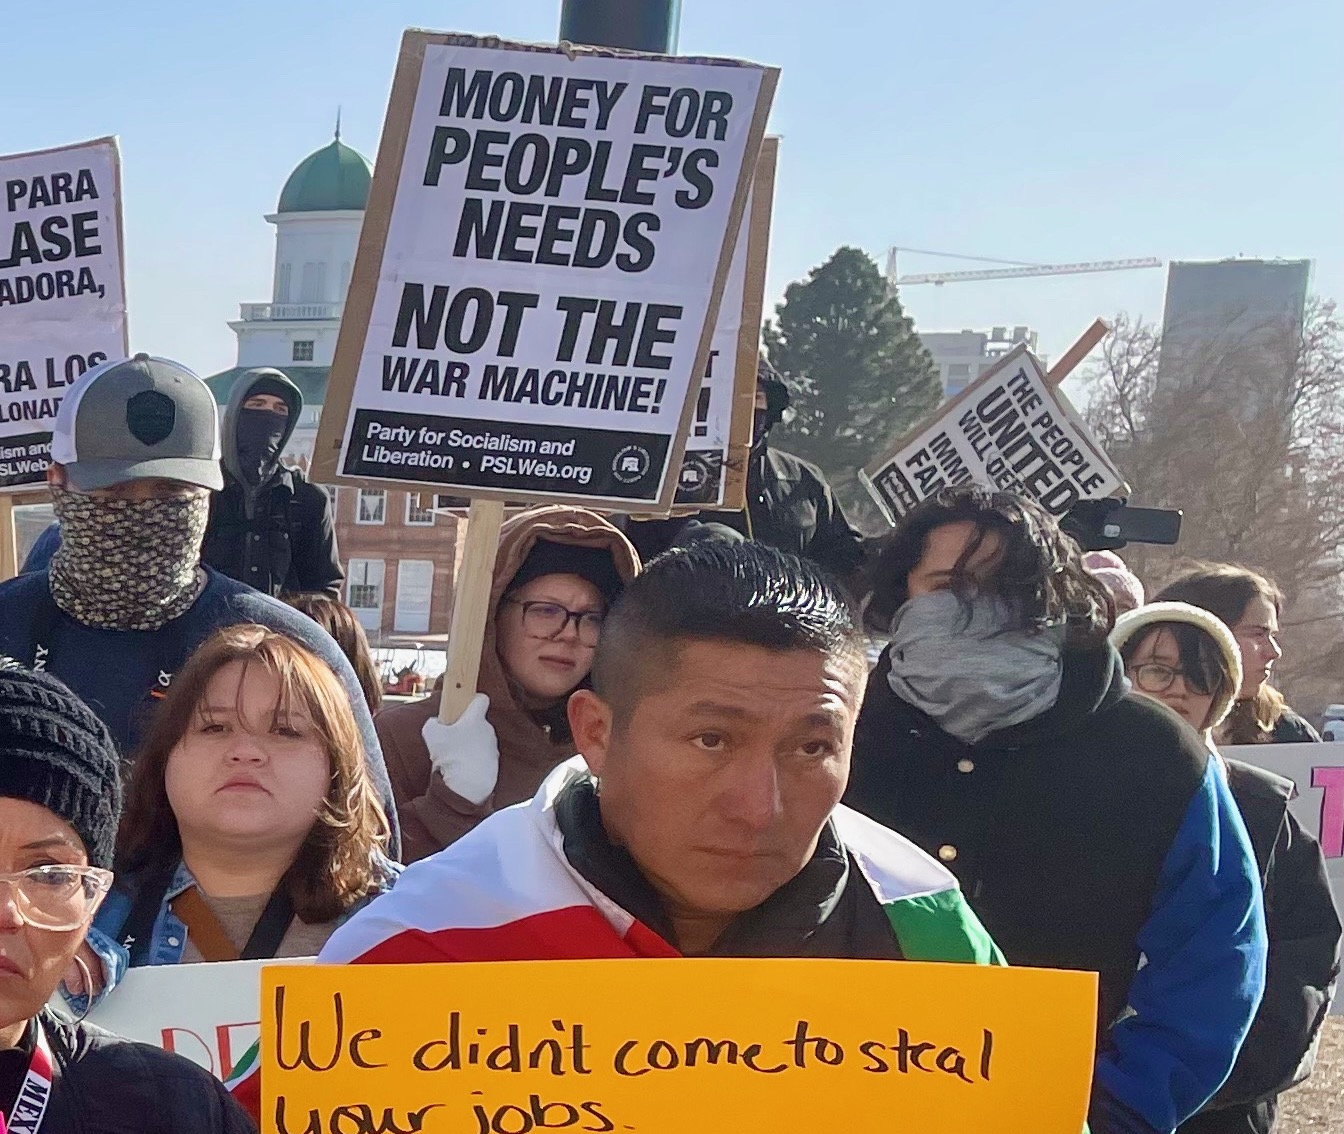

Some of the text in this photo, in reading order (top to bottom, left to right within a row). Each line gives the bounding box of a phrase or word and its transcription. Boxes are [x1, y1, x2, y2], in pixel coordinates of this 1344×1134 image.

[438, 67, 733, 141] MONEY FOR
[7, 169, 99, 211] PARA
[423, 126, 719, 210] PEOPLE'S
[452, 198, 662, 273] NEEDS
[391, 282, 683, 370] NOT THE
[381, 355, 470, 399] WAR
[479, 364, 666, 414] MACHINE!
[361, 445, 593, 484] Liberation PSLWeb.org
[366, 422, 576, 457] Party for Socialism and
[958, 409, 992, 462] WILL
[976, 385, 1080, 516] UNITED
[1007, 367, 1105, 495] THE PEOPLE
[275, 984, 389, 1072] We
[413, 1011, 592, 1076] didn't
[614, 1036, 788, 1076] come
[783, 1020, 844, 1068] to
[859, 1028, 993, 1084] steal
